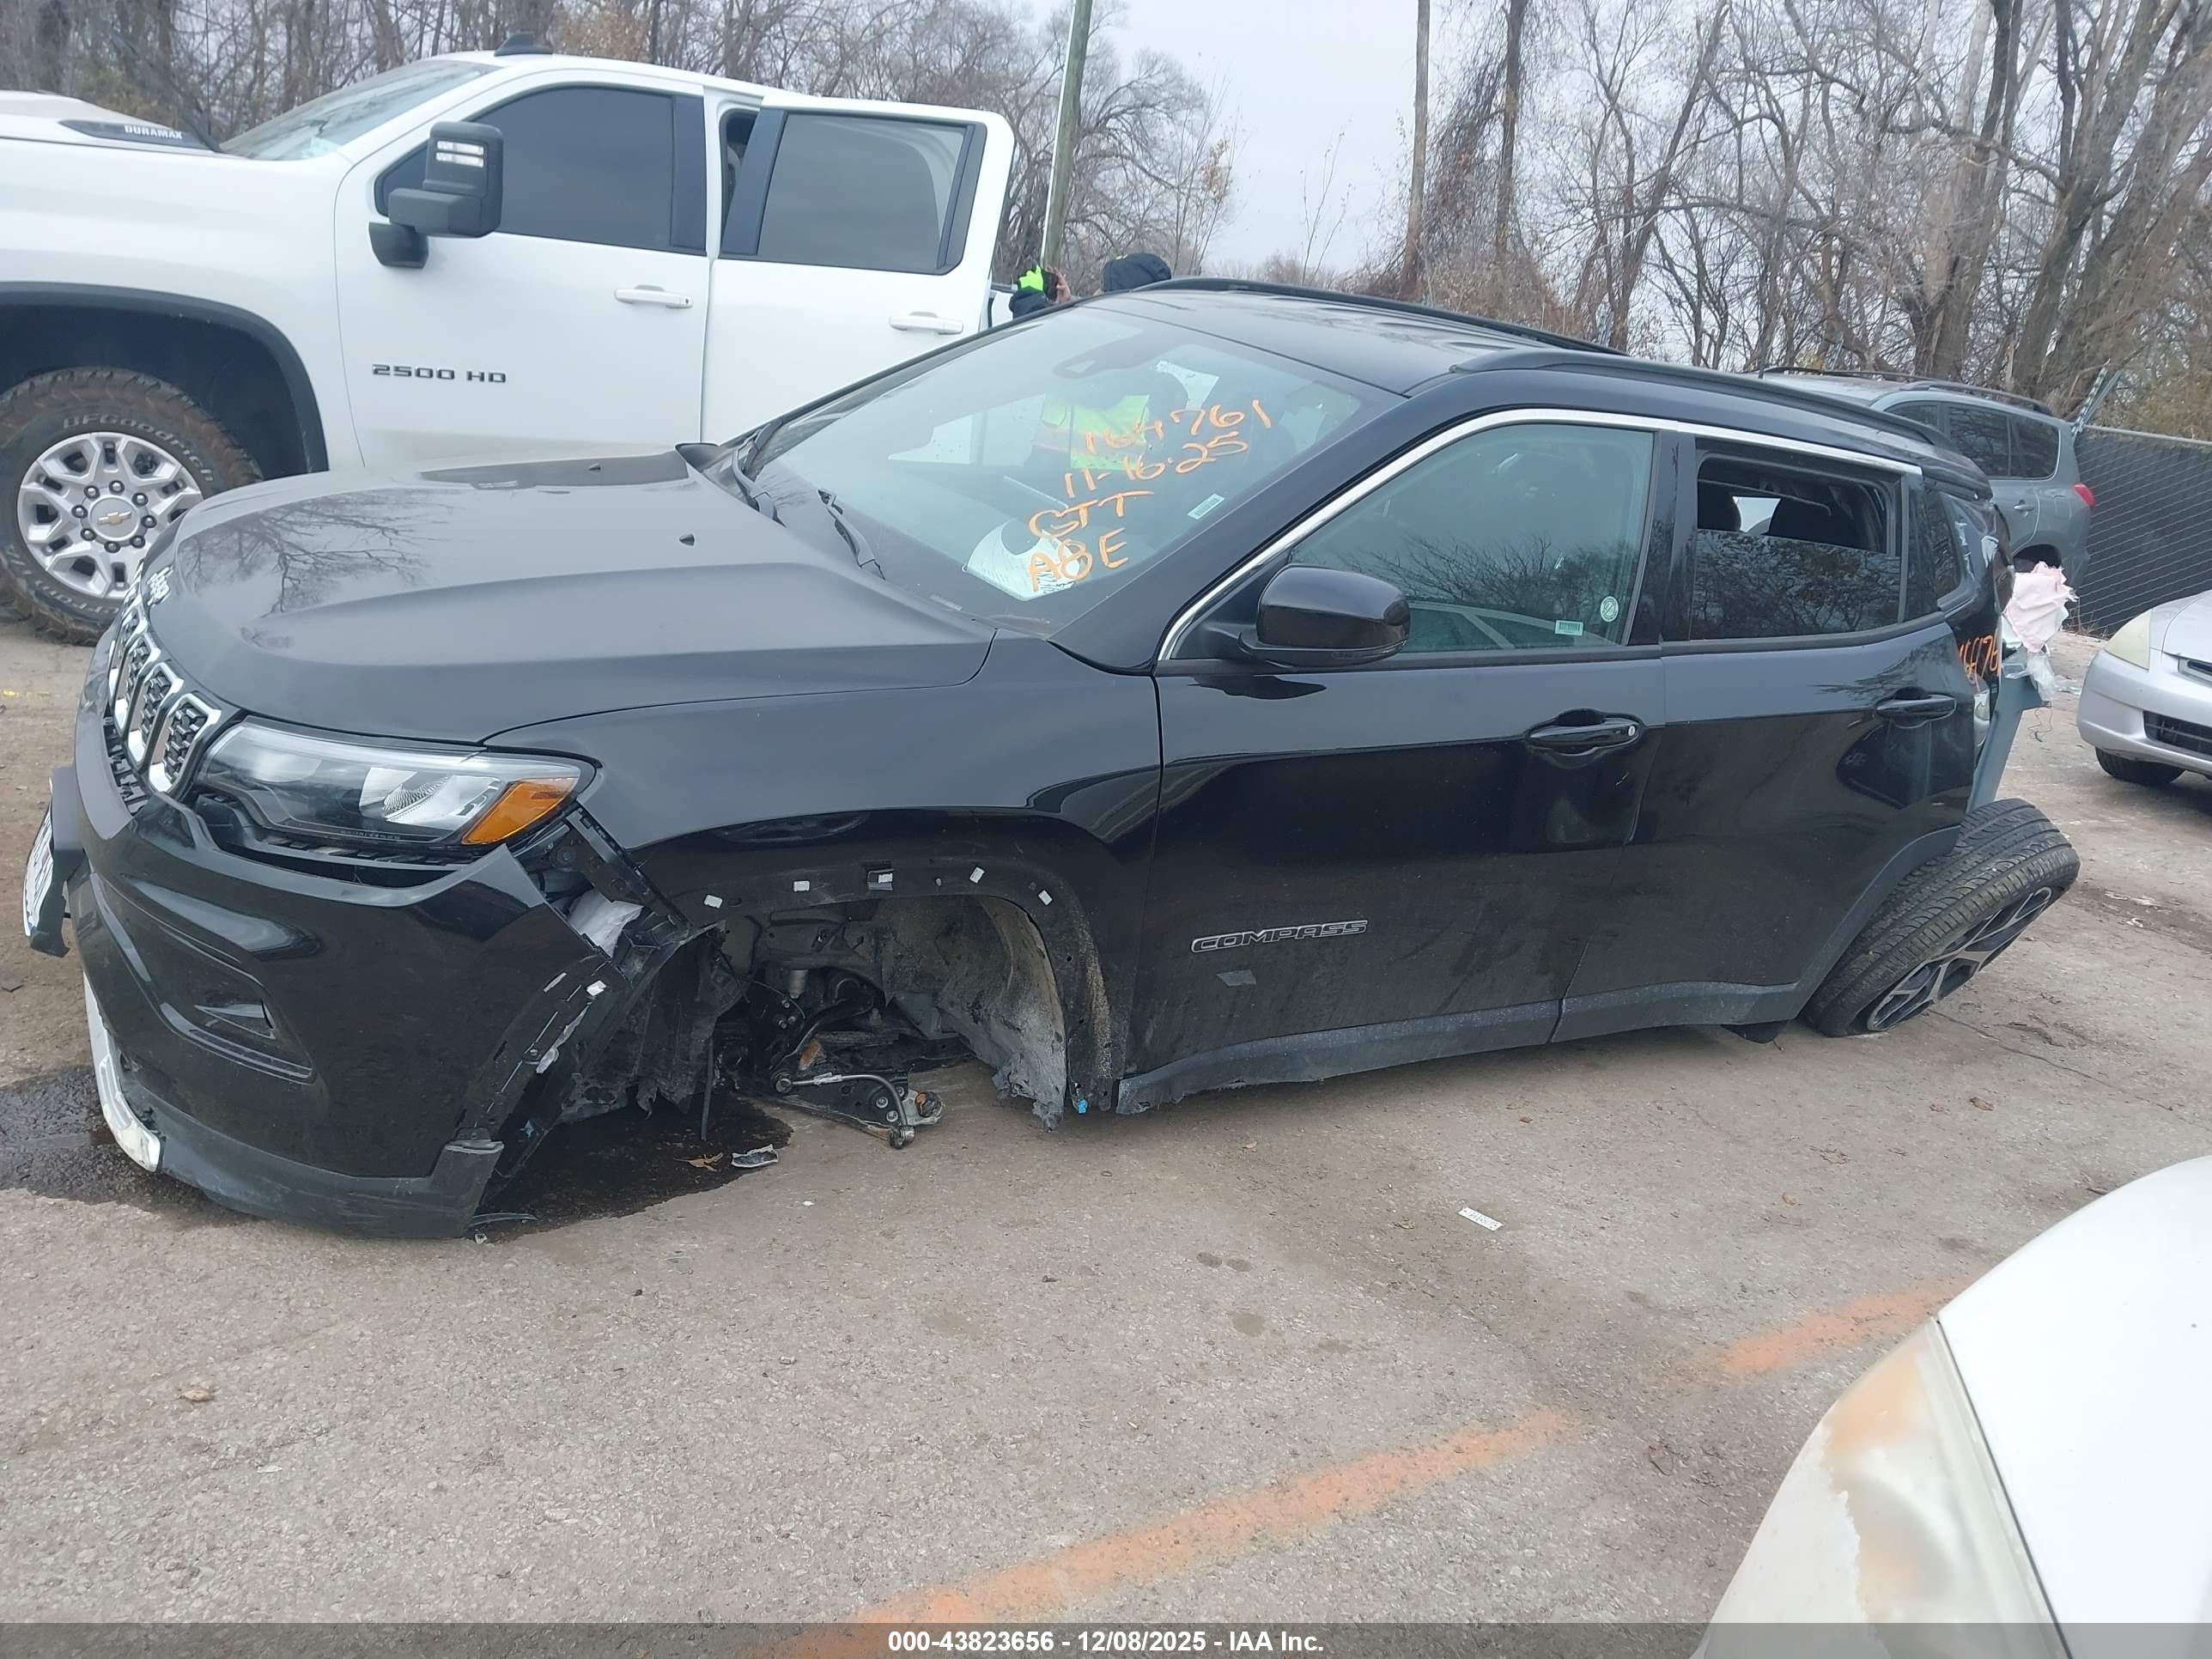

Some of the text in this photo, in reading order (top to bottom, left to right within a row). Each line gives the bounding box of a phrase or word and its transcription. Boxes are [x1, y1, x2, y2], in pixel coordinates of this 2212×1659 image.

[124, 124, 183, 140] DURAMAX
[372, 364, 507, 383] 2500 HD
[63, 413, 214, 482] BFGoodrich
[1029, 490, 1155, 538] GTT
[1191, 920, 1368, 953] COMPASS
